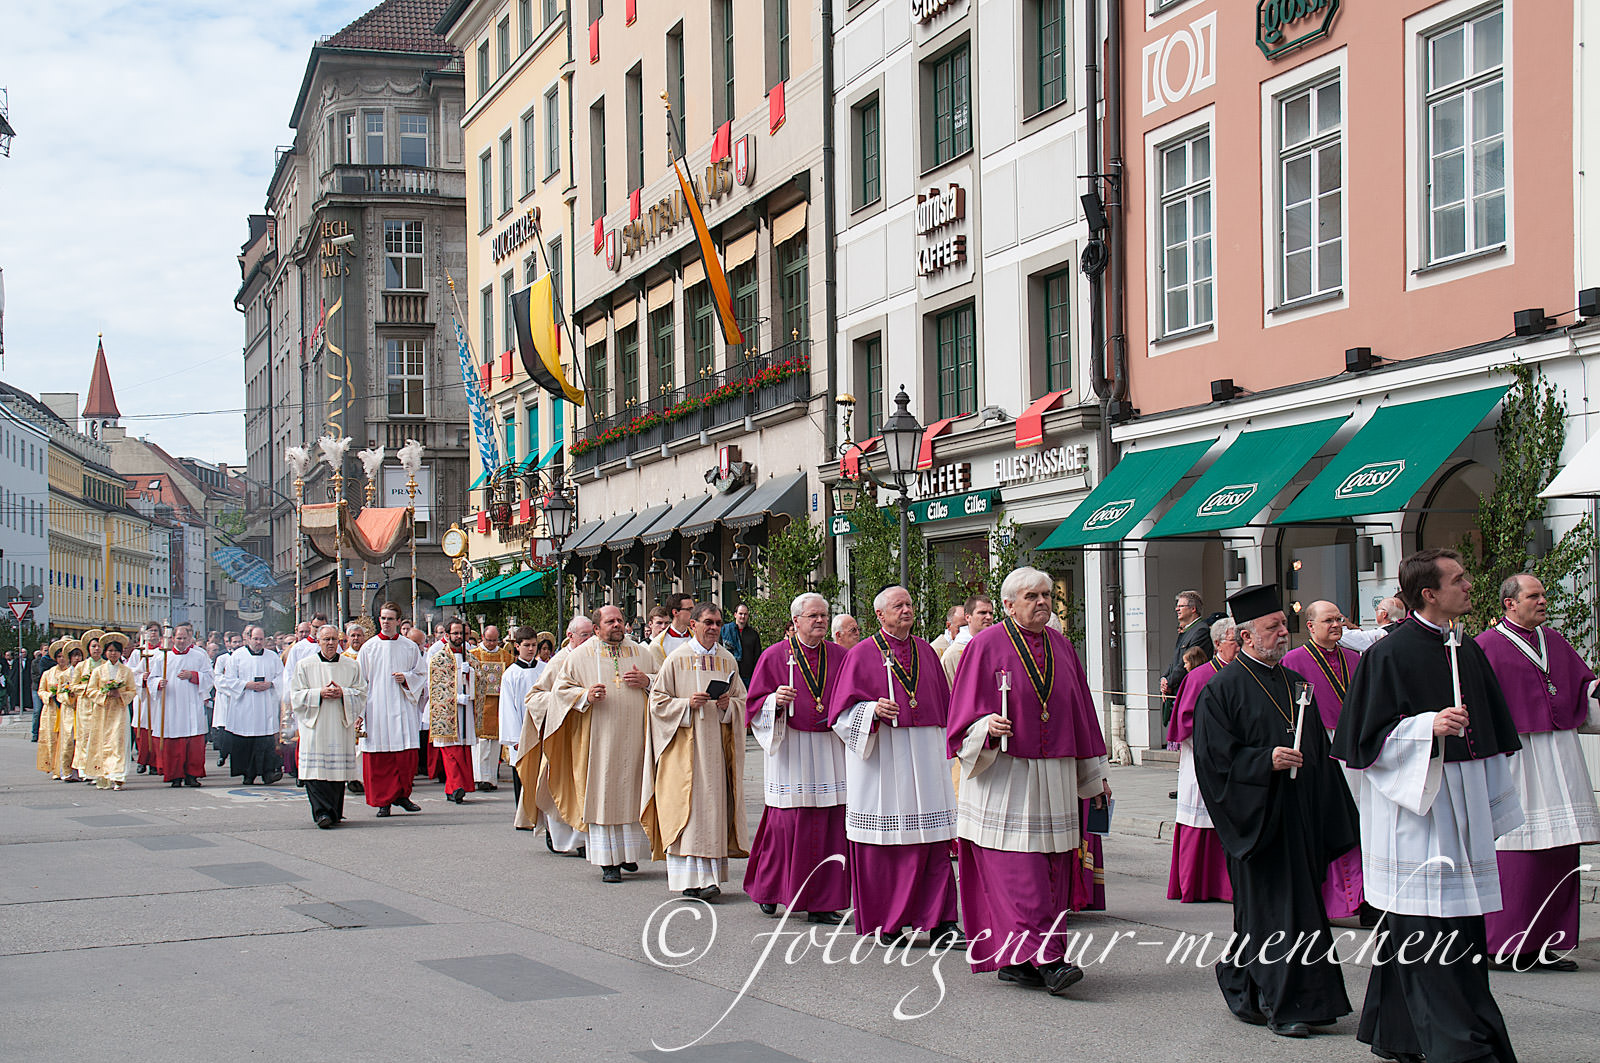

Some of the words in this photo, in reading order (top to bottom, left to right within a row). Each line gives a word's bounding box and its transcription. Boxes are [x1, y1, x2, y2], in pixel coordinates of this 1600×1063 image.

[916, 235, 967, 277] KAFFEE
[913, 462, 971, 498] KAFFEE
[993, 453, 1027, 483] EILLES
[1029, 443, 1087, 477] PASSAGE
[927, 501, 948, 520] Eilles
[964, 494, 987, 515] Eilles
